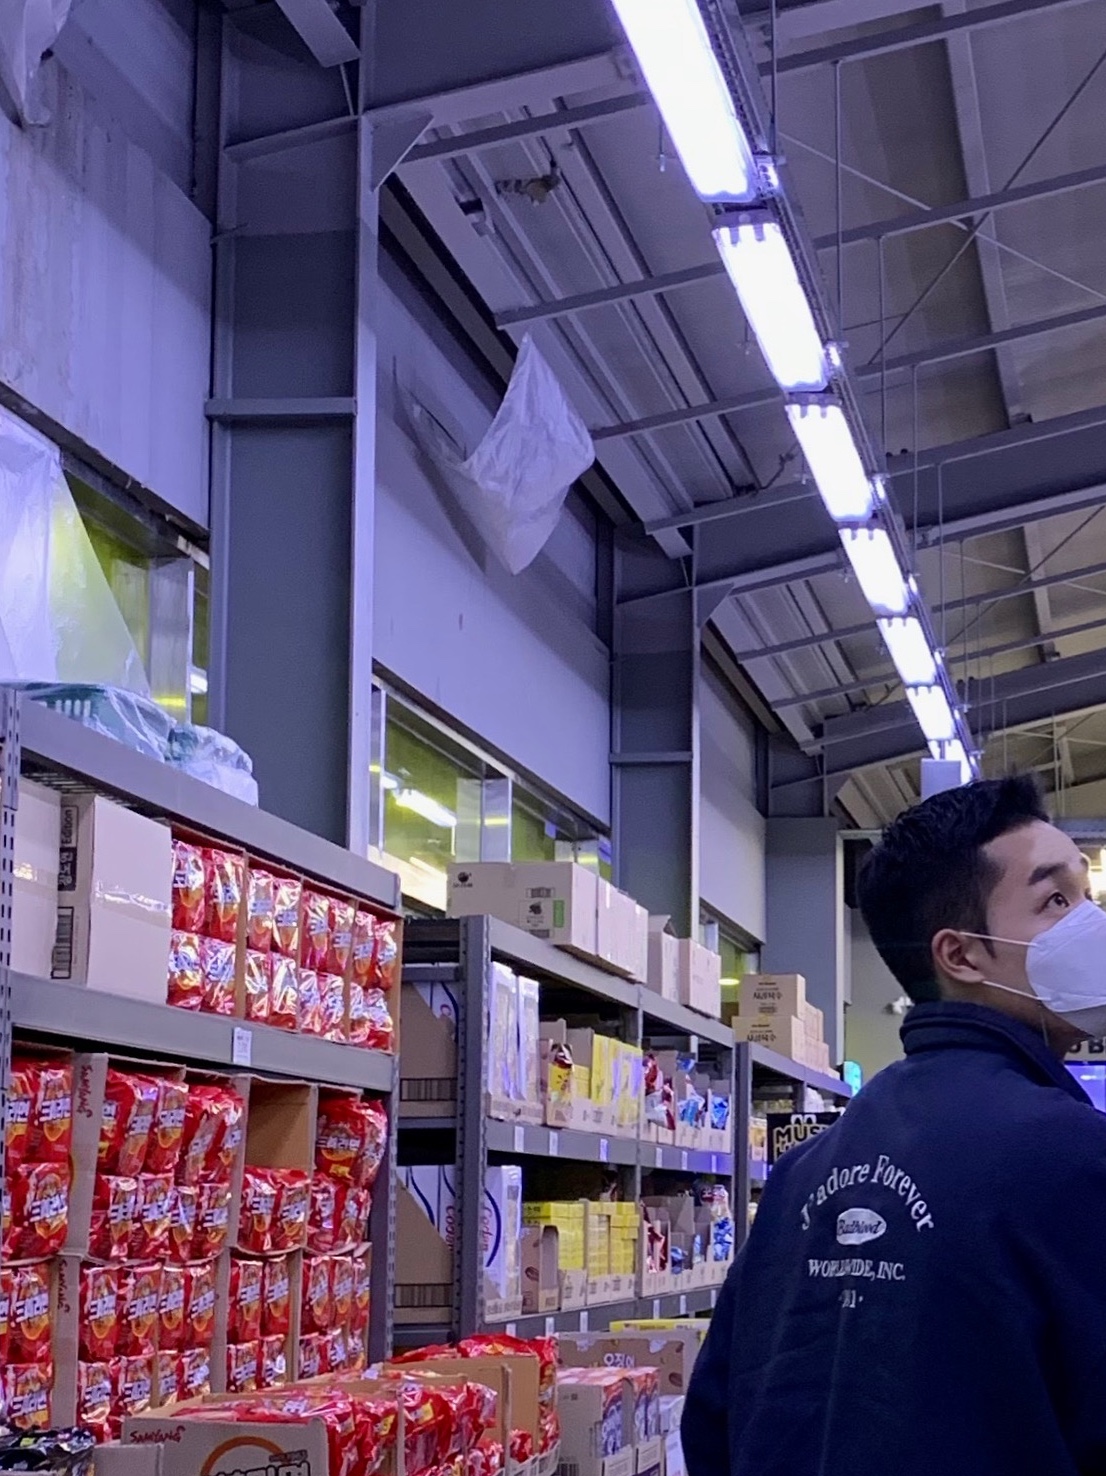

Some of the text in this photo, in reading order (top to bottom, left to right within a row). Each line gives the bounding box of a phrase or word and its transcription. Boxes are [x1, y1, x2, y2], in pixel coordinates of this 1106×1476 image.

[63, 808, 74, 845] Edition
[871, 1154, 935, 1233] Forever
[129, 1425, 186, 1444] SAMYANG
